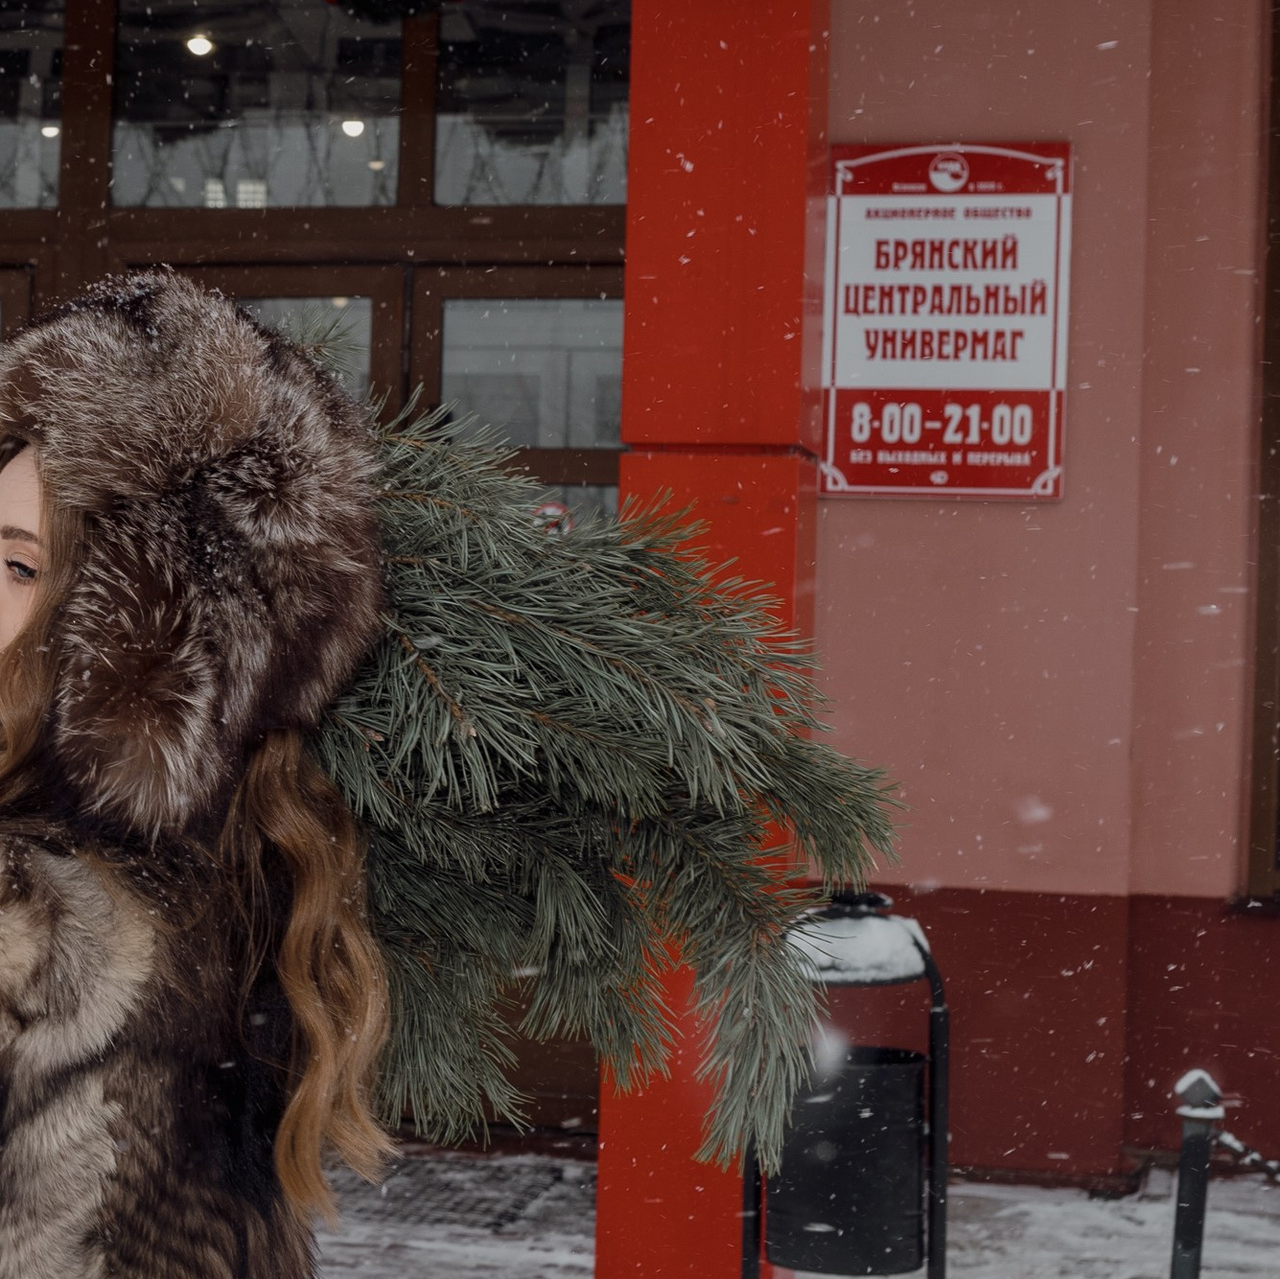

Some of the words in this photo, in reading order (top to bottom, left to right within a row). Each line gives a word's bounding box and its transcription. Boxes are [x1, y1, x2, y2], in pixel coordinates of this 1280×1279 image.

[875, 233, 1018, 271] БРЯНСКИЙ
[844, 279, 1047, 316] ЦЕНТРАЛЬНЫЙ
[865, 328, 1024, 361] УНИВЕРМАГ
